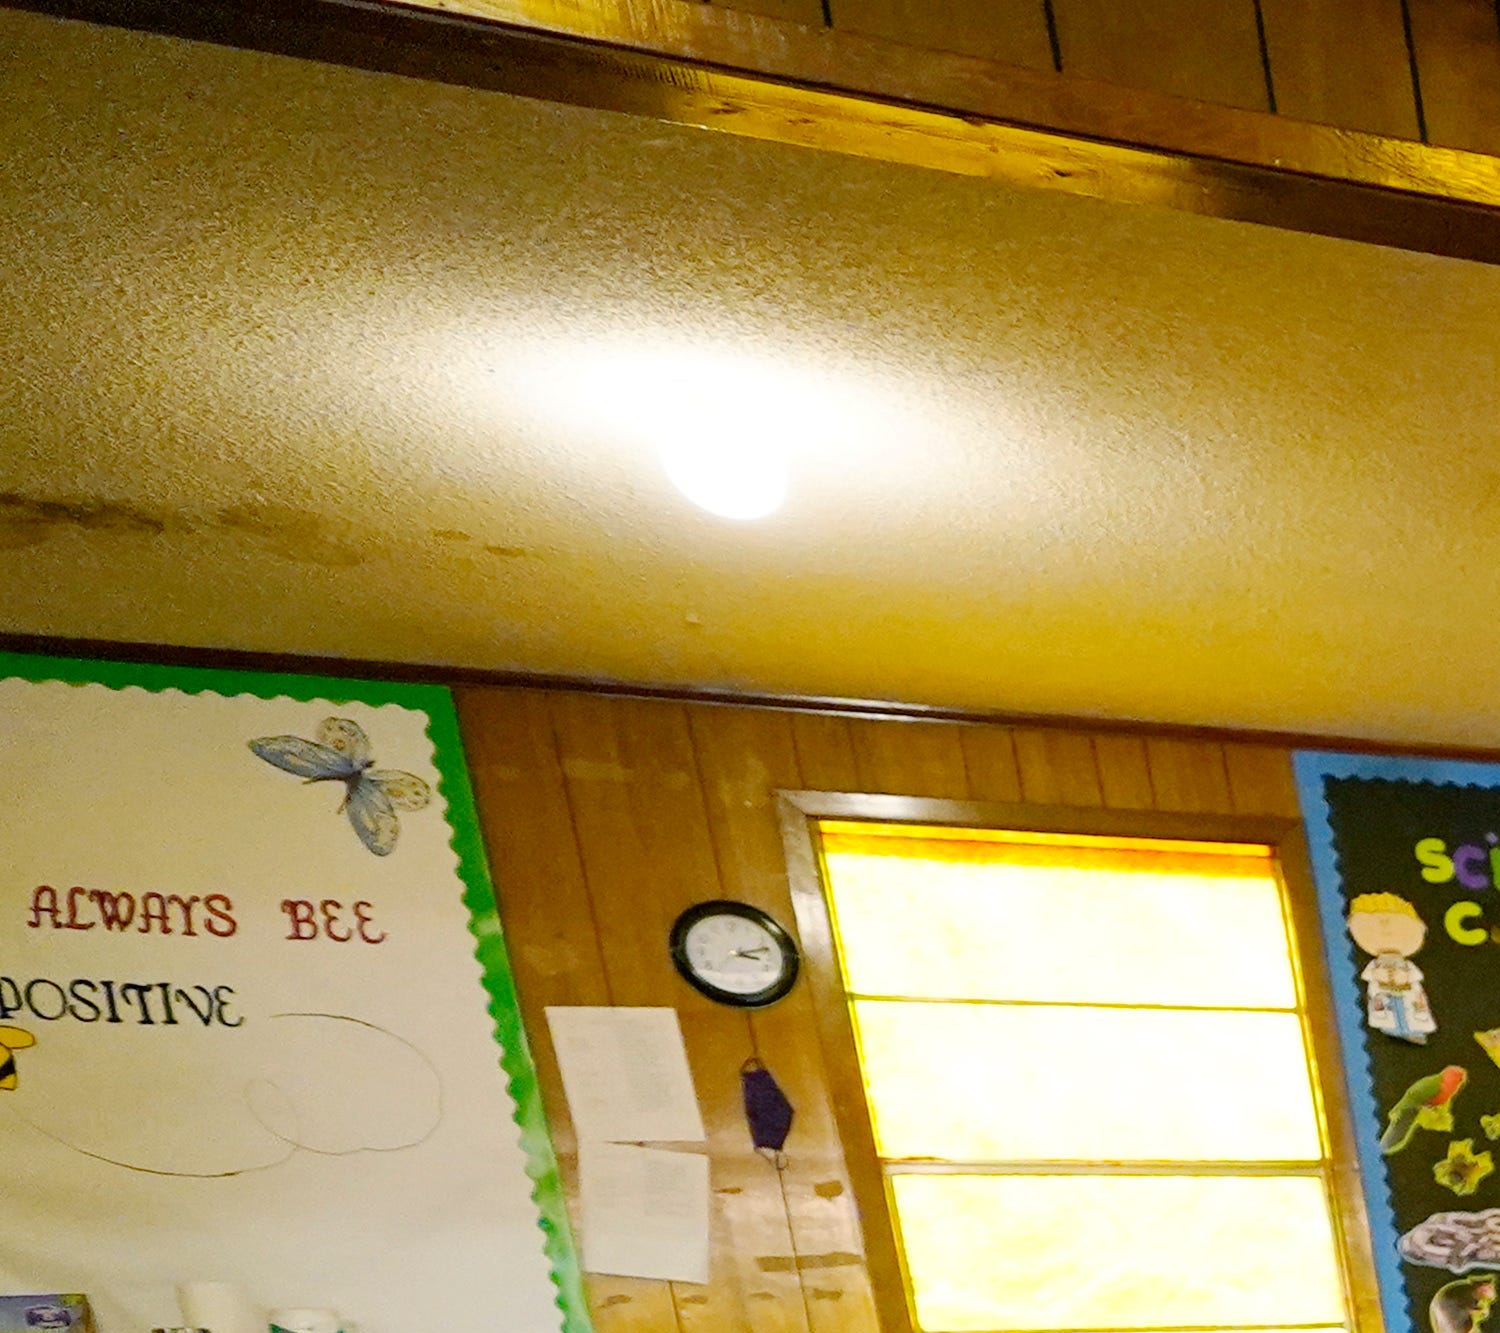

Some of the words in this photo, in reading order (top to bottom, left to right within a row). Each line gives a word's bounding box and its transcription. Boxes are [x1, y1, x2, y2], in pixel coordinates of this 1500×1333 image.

[27, 885, 238, 937] ALWAYS
[280, 898, 389, 945] BEE
[0, 976, 246, 1028] POSITIVE
